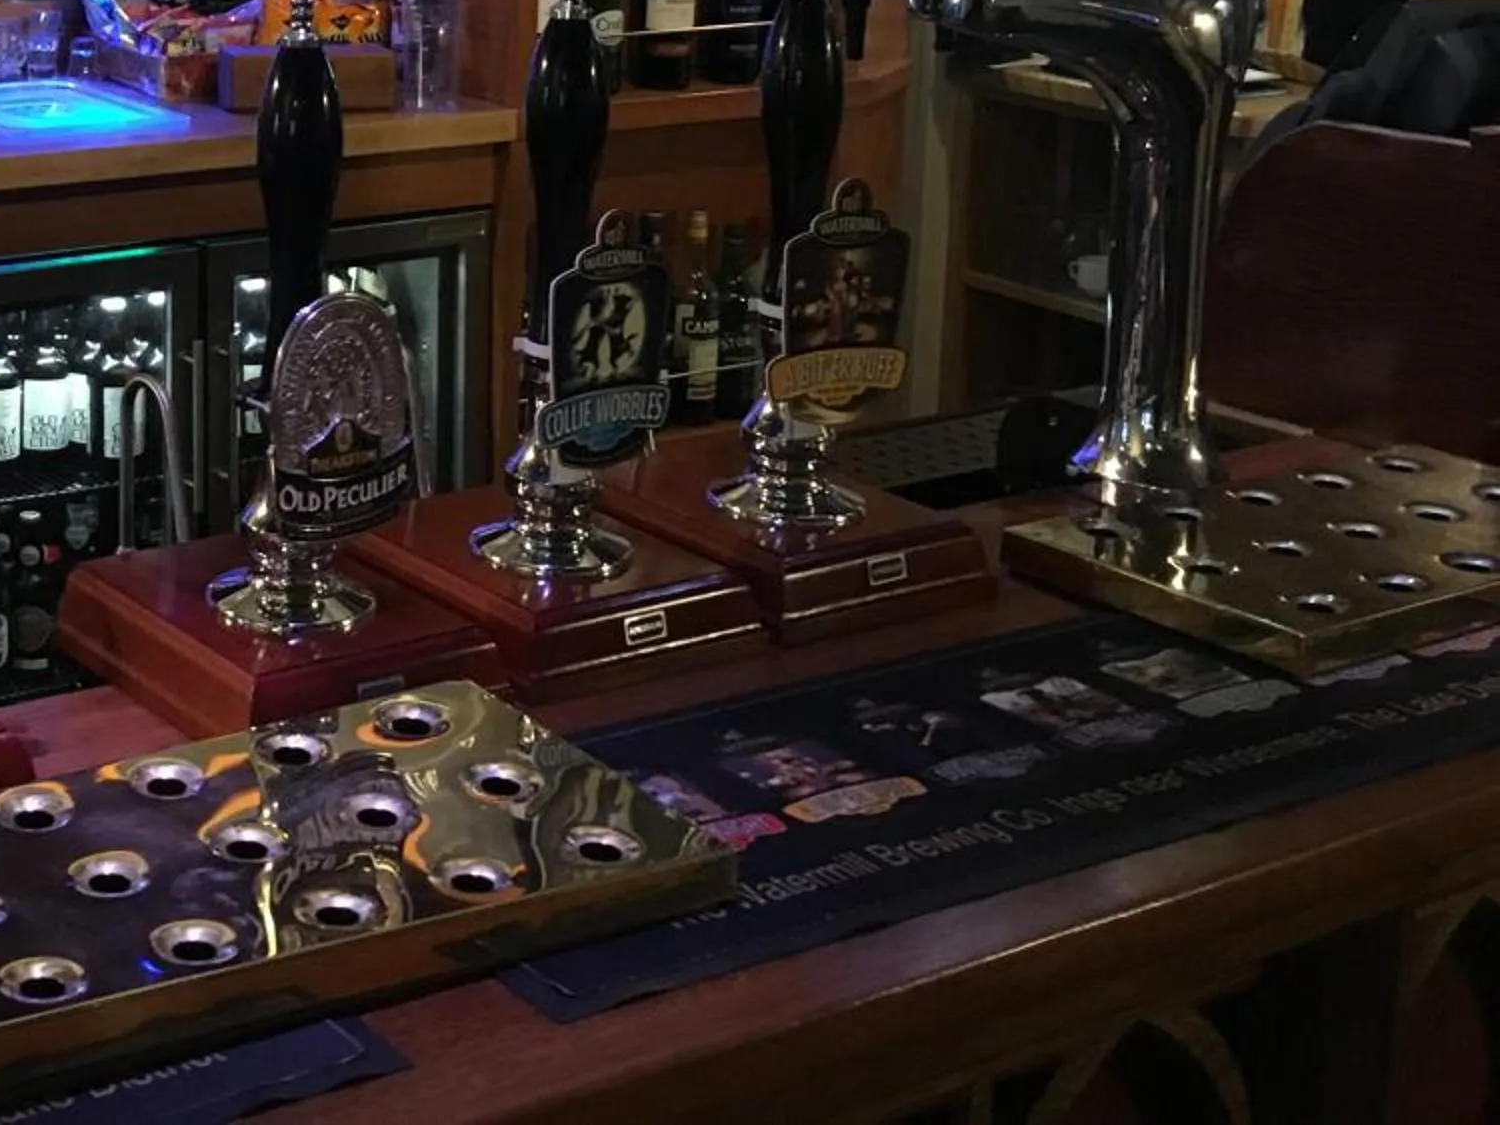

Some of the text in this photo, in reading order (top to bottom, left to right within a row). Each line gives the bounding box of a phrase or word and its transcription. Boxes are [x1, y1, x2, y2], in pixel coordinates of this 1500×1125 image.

[545, 390, 666, 440] COLLIE WOBBLES
[279, 462, 409, 512] OLD PECULIER
[738, 845, 878, 911] Watermill
[865, 817, 1014, 869] Brewing
